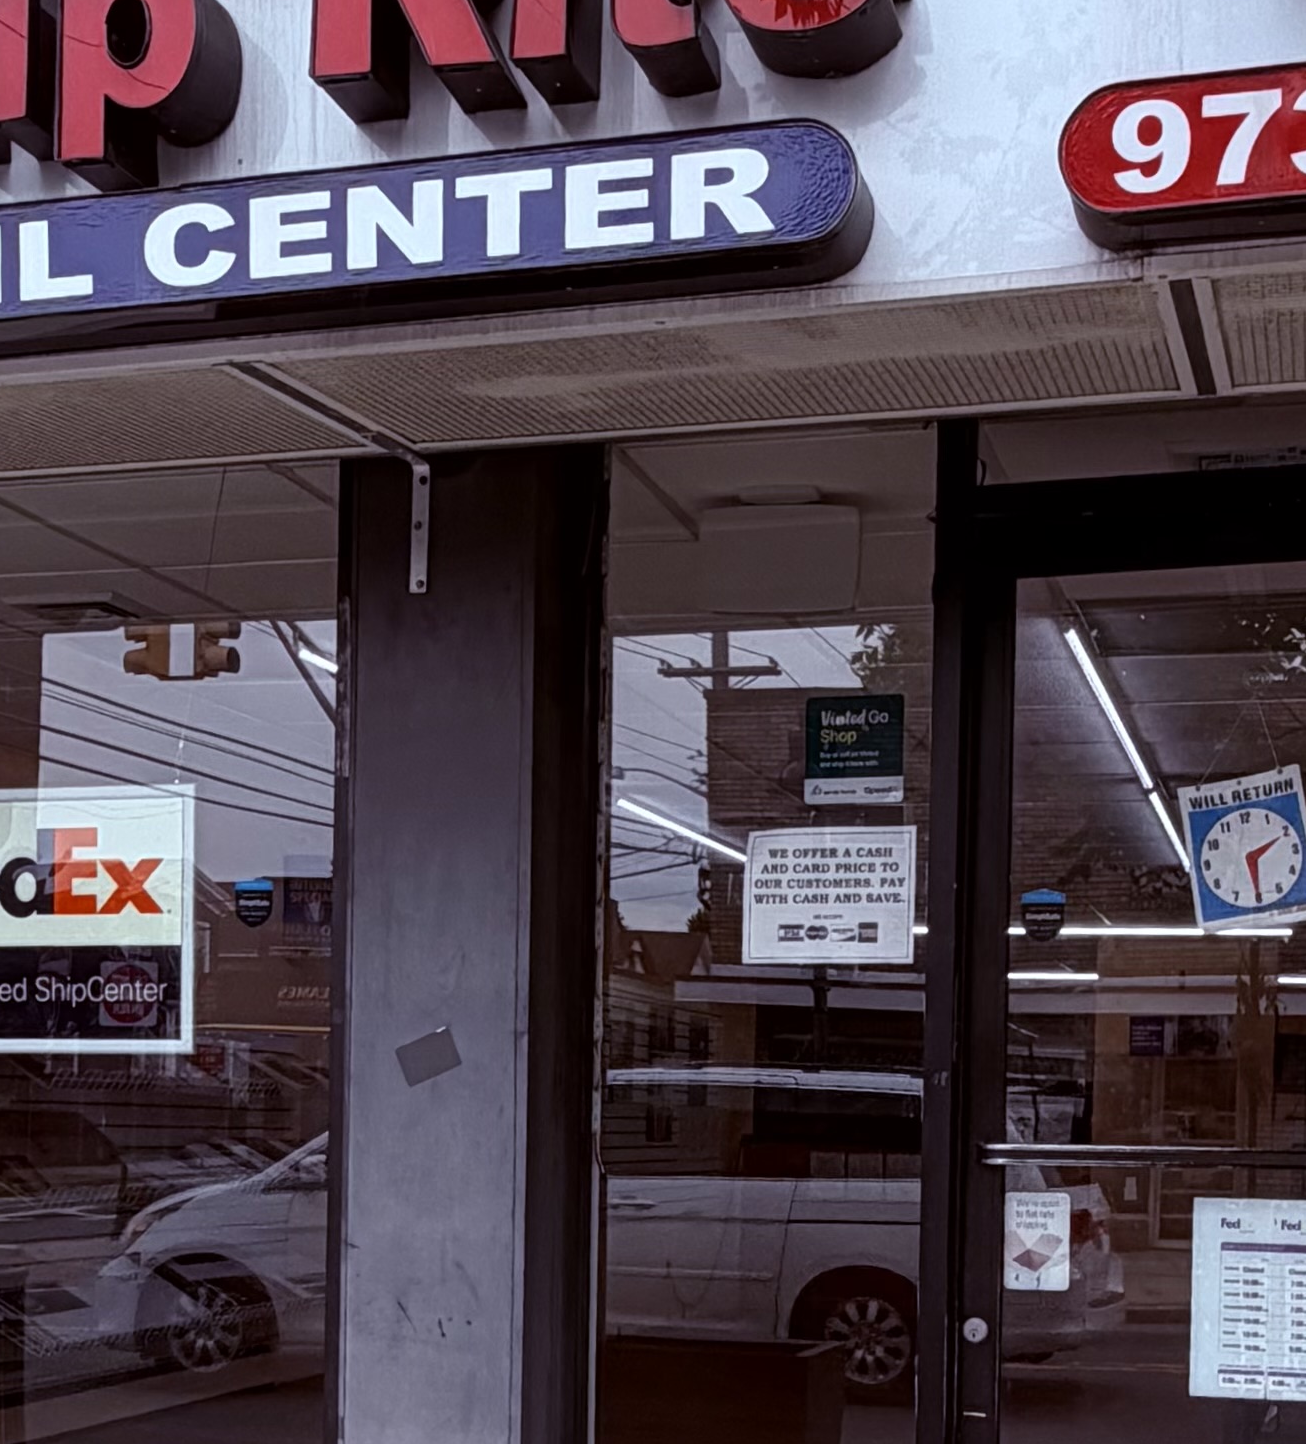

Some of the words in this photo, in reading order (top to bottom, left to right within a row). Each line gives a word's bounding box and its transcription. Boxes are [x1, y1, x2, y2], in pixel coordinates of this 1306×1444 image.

[143, 147, 776, 288] CENTER
[868, 709, 889, 724] Go
[820, 729, 857, 745] Shop
[1189, 793, 1228, 810] WILL
[1232, 777, 1294, 803] RETURN
[1239, 811, 1251, 824] 12
[1265, 813, 1271, 825] 1
[1220, 822, 1231, 833] 11
[1282, 825, 1291, 837] 2
[1207, 839, 1220, 851] 10
[1291, 843, 1300, 855] 3
[768, 849, 788, 858] WE
[792, 848, 838, 858] OFFER
[843, 848, 851, 858] A
[856, 847, 893, 857] CASH
[761, 864, 788, 874] AND
[793, 863, 830, 874] CARD
[835, 863, 875, 873] PRICE
[880, 862, 899, 872] TO
[1203, 860, 1211, 871] 9
[1289, 864, 1297, 876] 4
[754, 878, 782, 889] OUR
[787, 878, 874, 889] CUSTOMERS.
[880, 877, 906, 887] PAY
[1213, 878, 1221, 890] 8
[1275, 882, 1283, 894] 5
[754, 894, 788, 904] WITH
[793, 894, 829, 904] CASH
[834, 894, 862, 903] AND
[866, 893, 906, 903] SAVE.
[1232, 891, 1240, 902] 7
[34, 975, 168, 1007] ShipCenter
